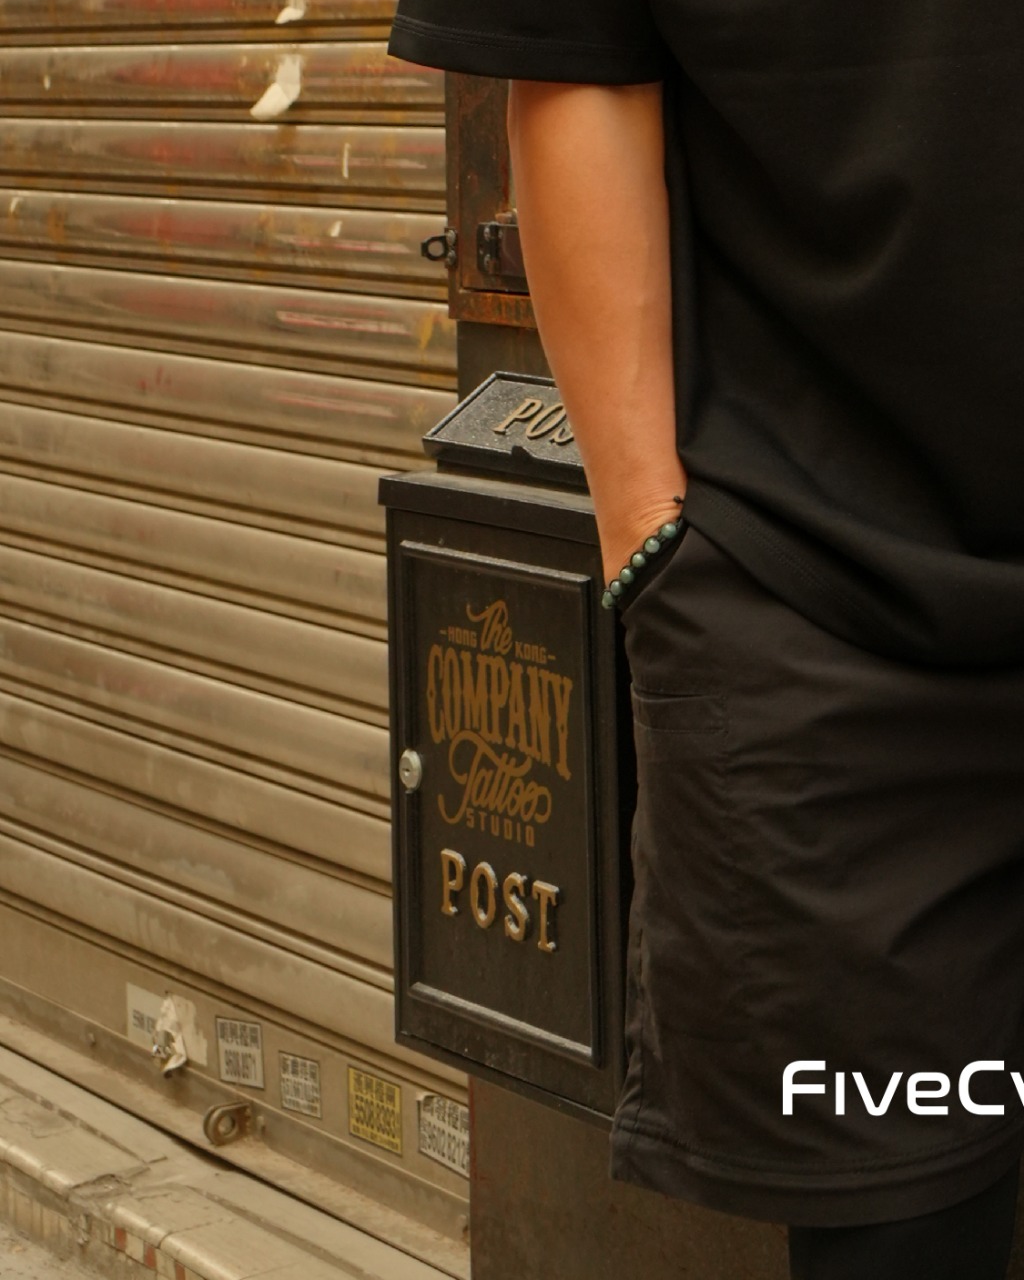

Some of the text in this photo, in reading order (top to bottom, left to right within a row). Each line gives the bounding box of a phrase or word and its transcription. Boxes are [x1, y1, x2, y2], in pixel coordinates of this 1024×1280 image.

[466, 599, 513, 655] The
[426, 644, 573, 781] COMPANY
[438, 729, 551, 824] Tattoo
[466, 808, 535, 847] STUDIO
[440, 847, 560, 953] POST
